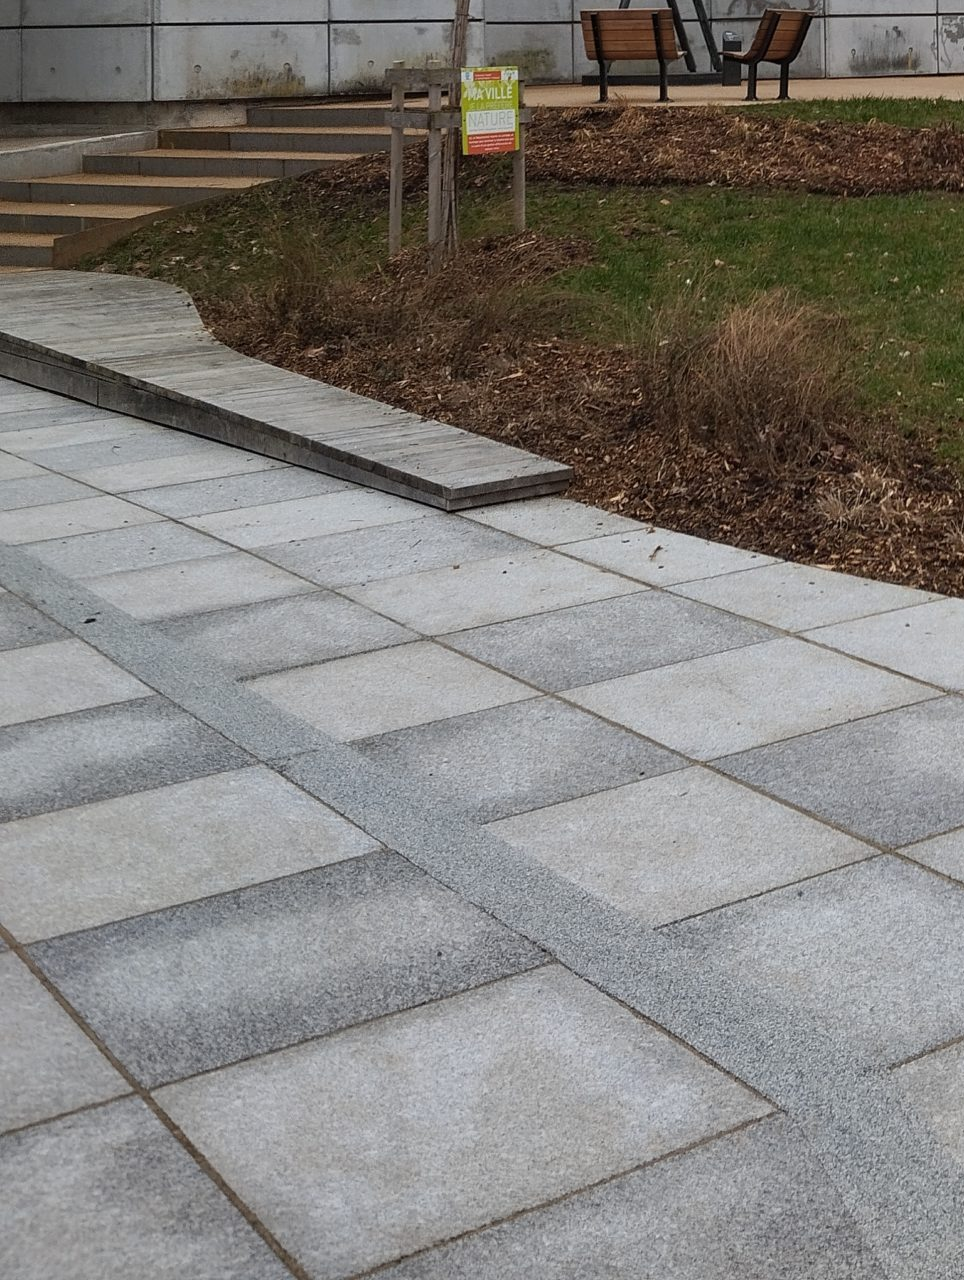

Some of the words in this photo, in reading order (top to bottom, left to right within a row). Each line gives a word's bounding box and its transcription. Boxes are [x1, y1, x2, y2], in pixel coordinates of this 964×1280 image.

[468, 87, 484, 101] MA
[485, 86, 513, 100] VILLE
[468, 110, 513, 128] NATURE
